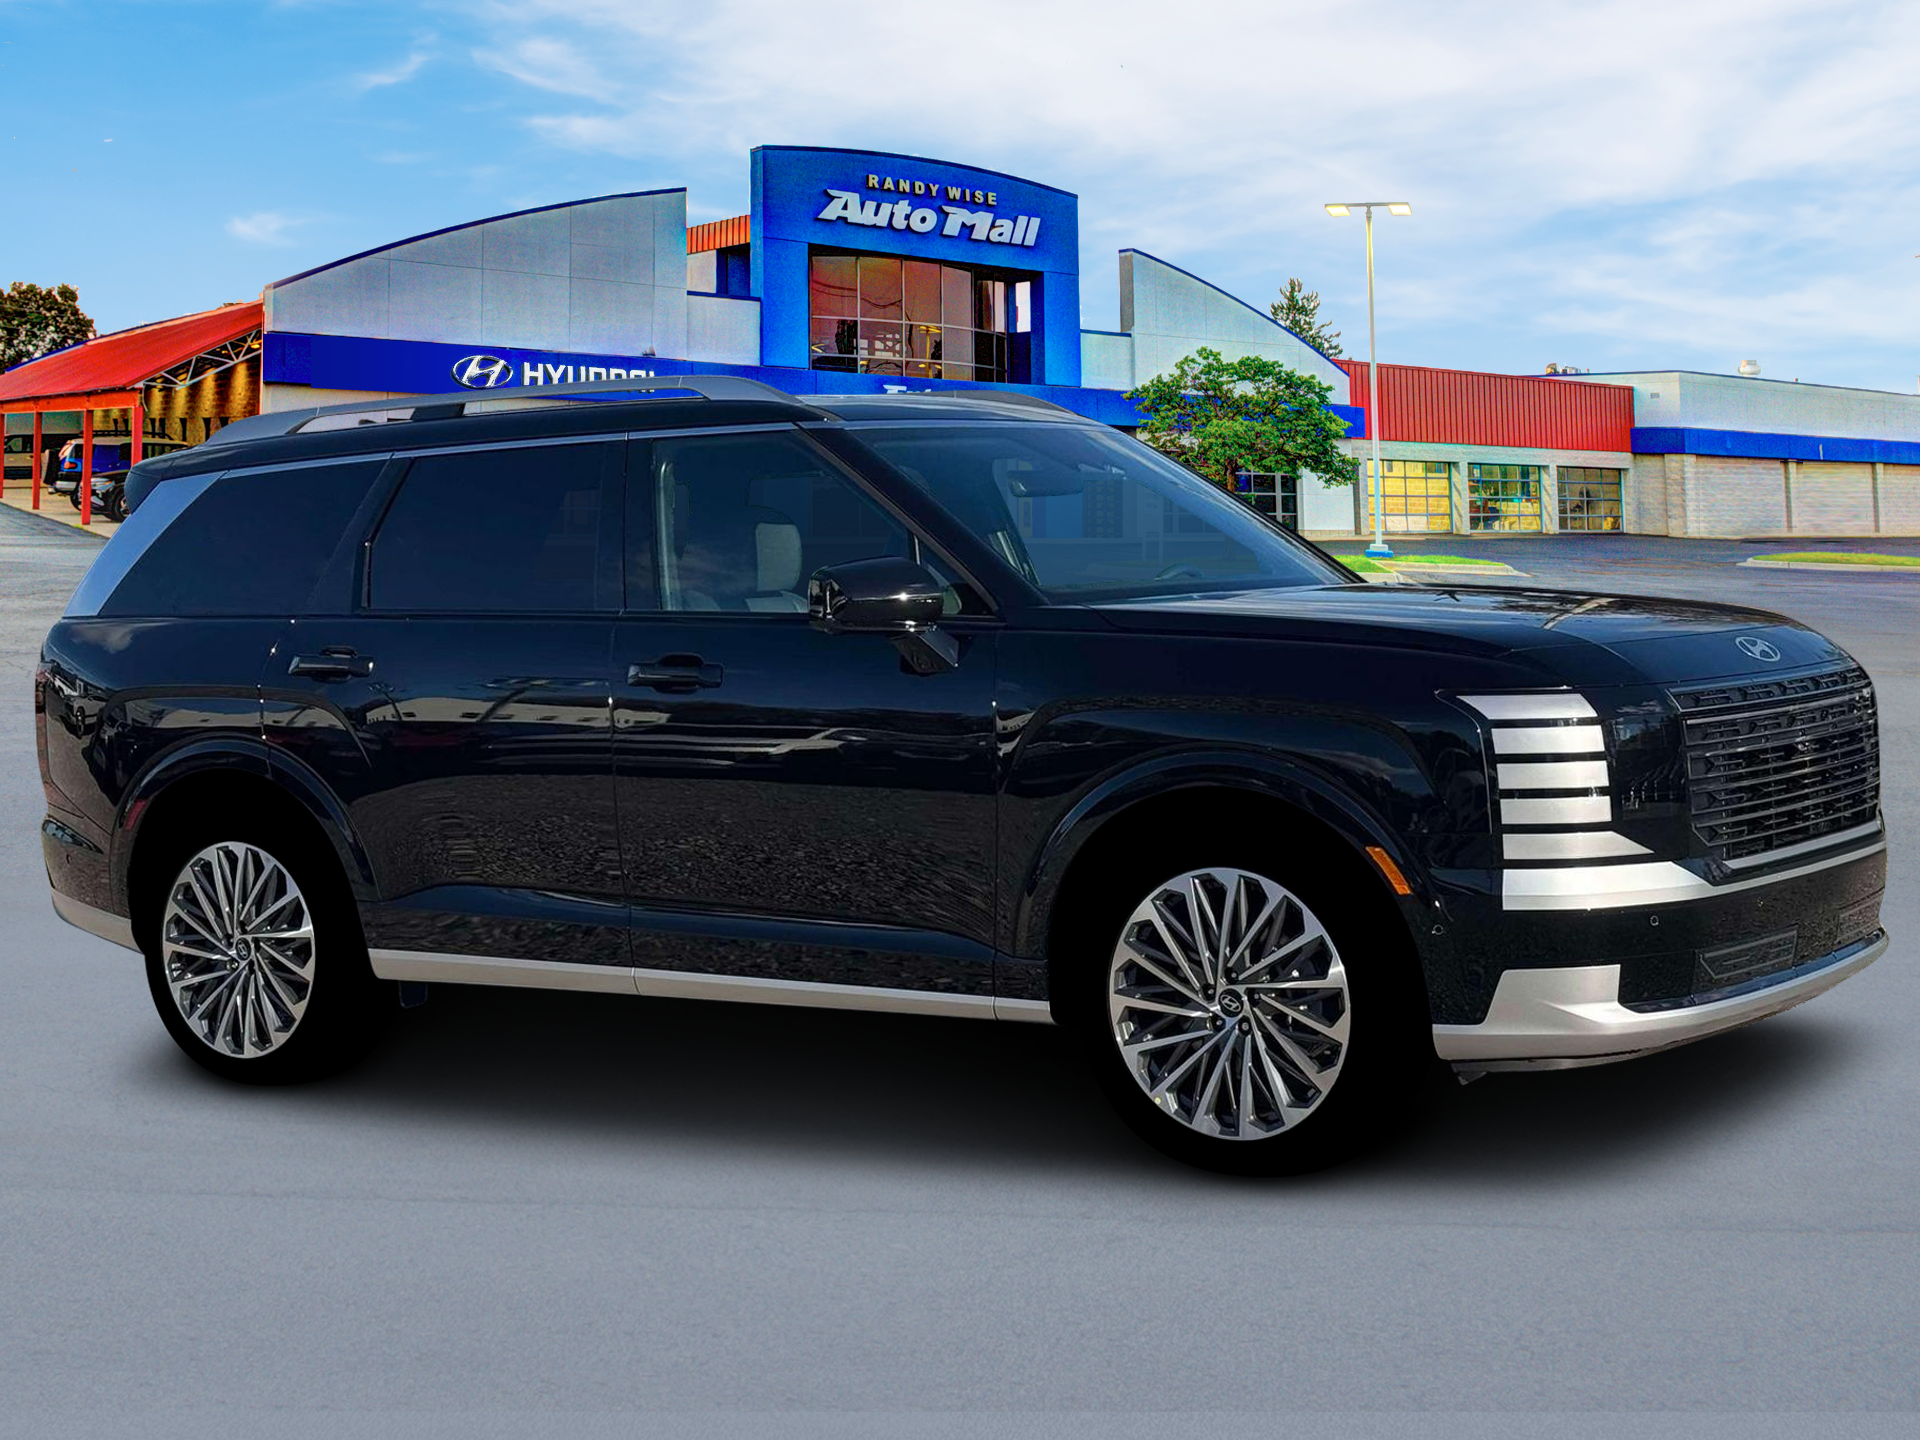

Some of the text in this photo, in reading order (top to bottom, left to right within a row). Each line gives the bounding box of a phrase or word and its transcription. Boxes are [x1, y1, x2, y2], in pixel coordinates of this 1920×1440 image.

[867, 174, 997, 206] RANDY WISE
[818, 189, 1040, 246] Auto Mall
